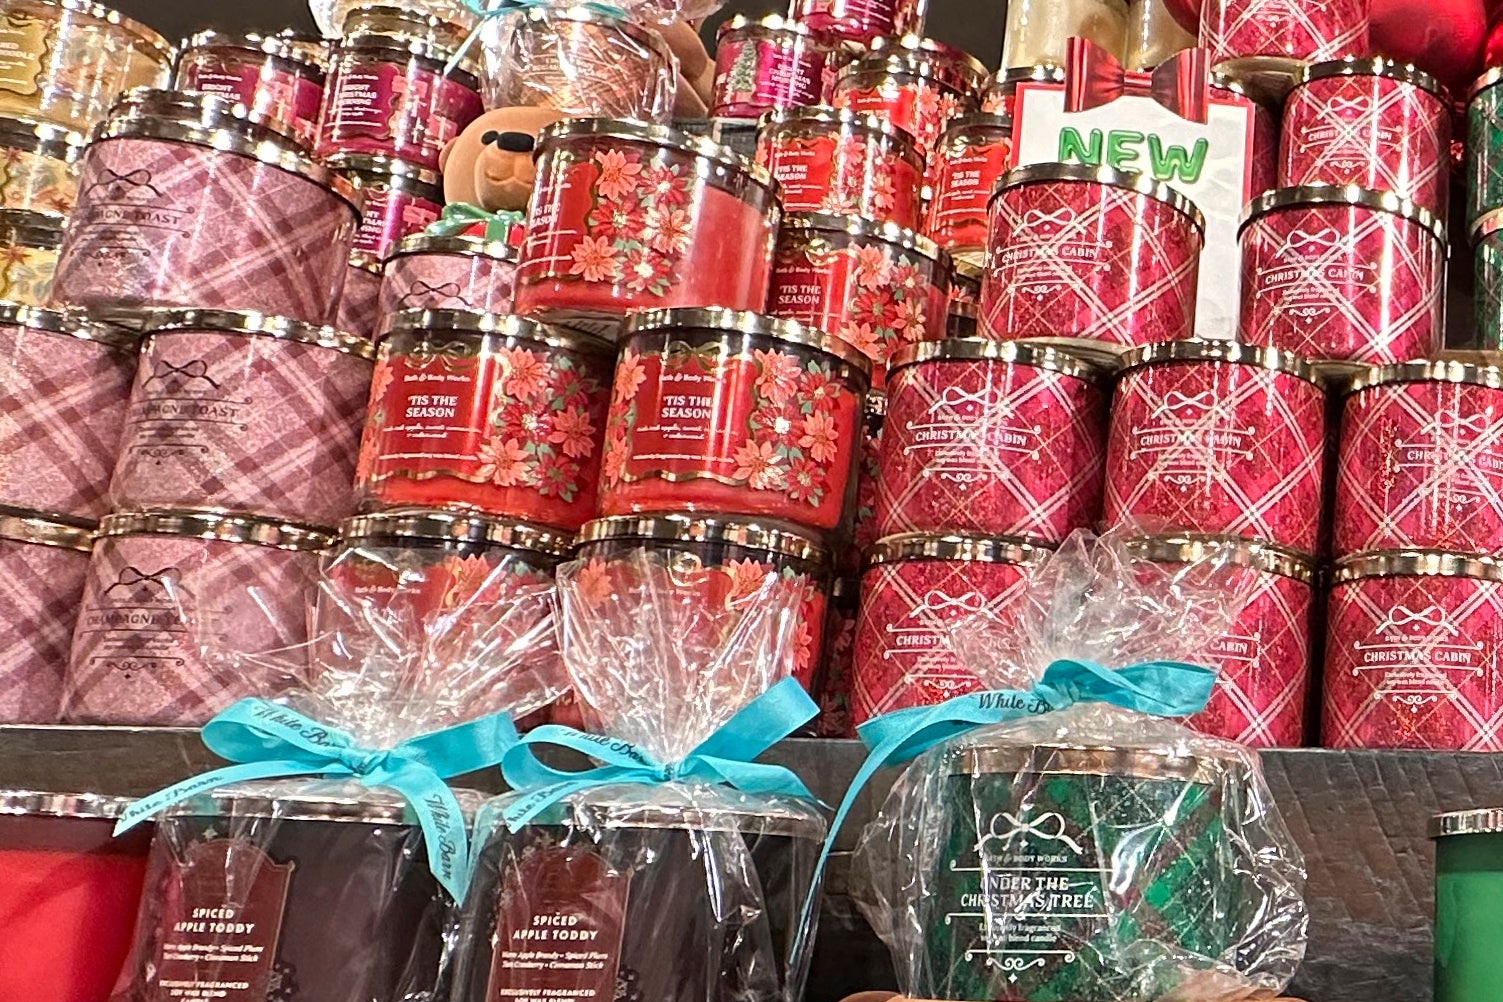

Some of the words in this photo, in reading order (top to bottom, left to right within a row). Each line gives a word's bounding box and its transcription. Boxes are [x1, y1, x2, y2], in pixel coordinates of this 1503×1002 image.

[1059, 126, 1208, 184] NEW
[792, 165, 808, 173] THE
[964, 170, 980, 178] THE
[800, 285, 821, 294] THE
[778, 294, 820, 305] SEASON
[408, 395, 430, 407] 'TIS
[433, 395, 457, 406] THE
[664, 395, 685, 407] 'TIS
[406, 407, 455, 419] SEASON
[1364, 651, 1431, 663] CHRISTMAS
[1435, 651, 1471, 664] CABIN
[978, 693, 1025, 710] White
[254, 705, 304, 732] White
[1035, 876, 1069, 891] THE
[961, 893, 1043, 908] CHRISTMAS
[1049, 892, 1094, 908] TREE
[192, 908, 234, 919] SPICED
[533, 914, 578, 926] SPICED
[174, 922, 205, 933] APPLE
[209, 923, 255, 934] TODDY
[513, 930, 548, 940] APPLE
[552, 930, 598, 940] TODDY
